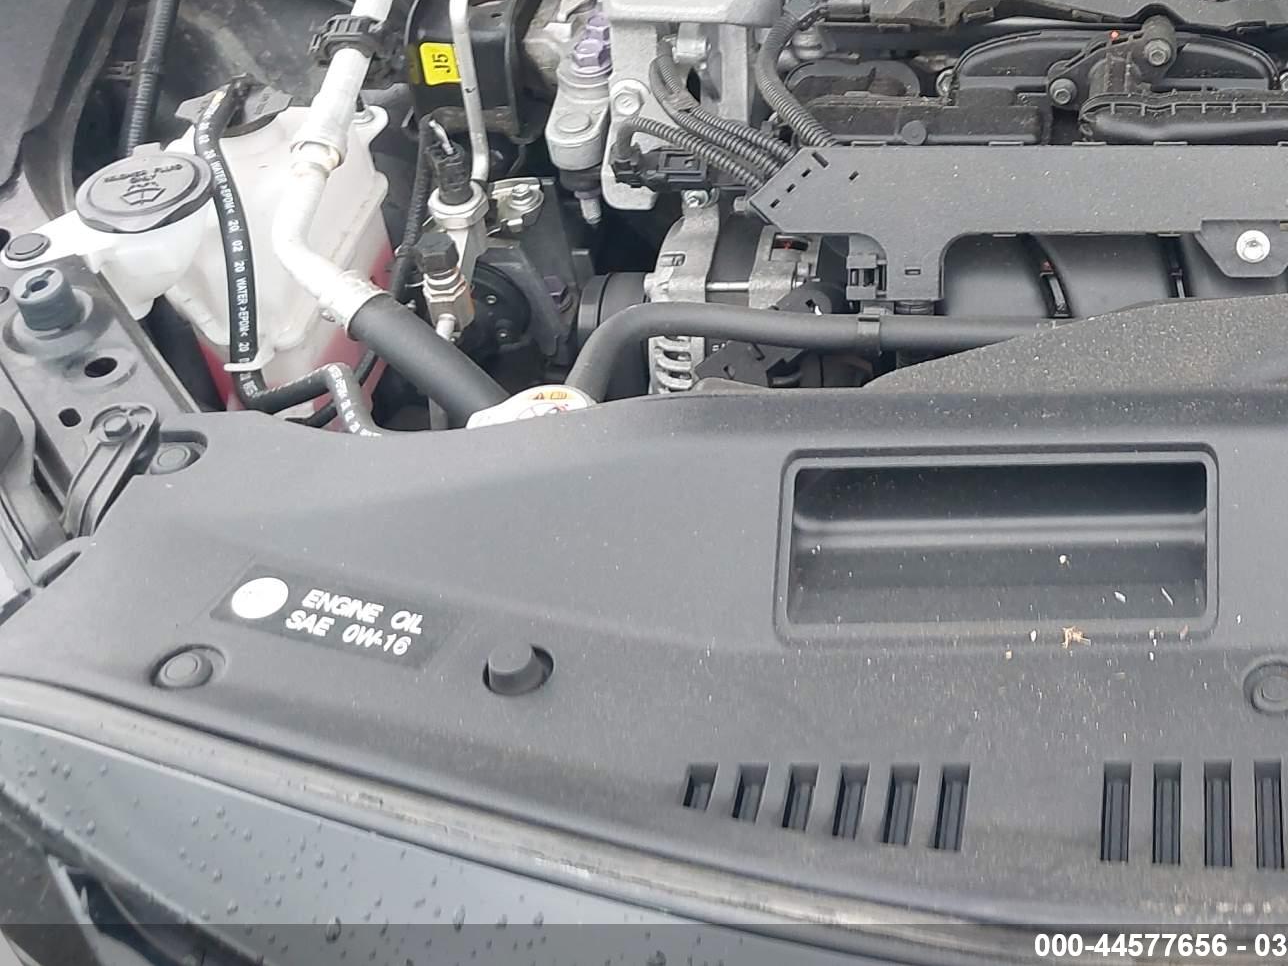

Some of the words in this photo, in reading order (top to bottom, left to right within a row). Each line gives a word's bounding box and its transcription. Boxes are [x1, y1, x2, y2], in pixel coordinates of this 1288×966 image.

[431, 53, 452, 74] J5
[211, 161, 227, 184] WATER
[232, 241, 243, 252] 02
[234, 261, 245, 273] 20
[235, 277, 249, 306] WATER
[239, 342, 249, 351] 20
[301, 588, 384, 624] ENGINE
[390, 609, 425, 635] OIL
[285, 609, 335, 637] SAE
[342, 623, 412, 656] 0W-16
